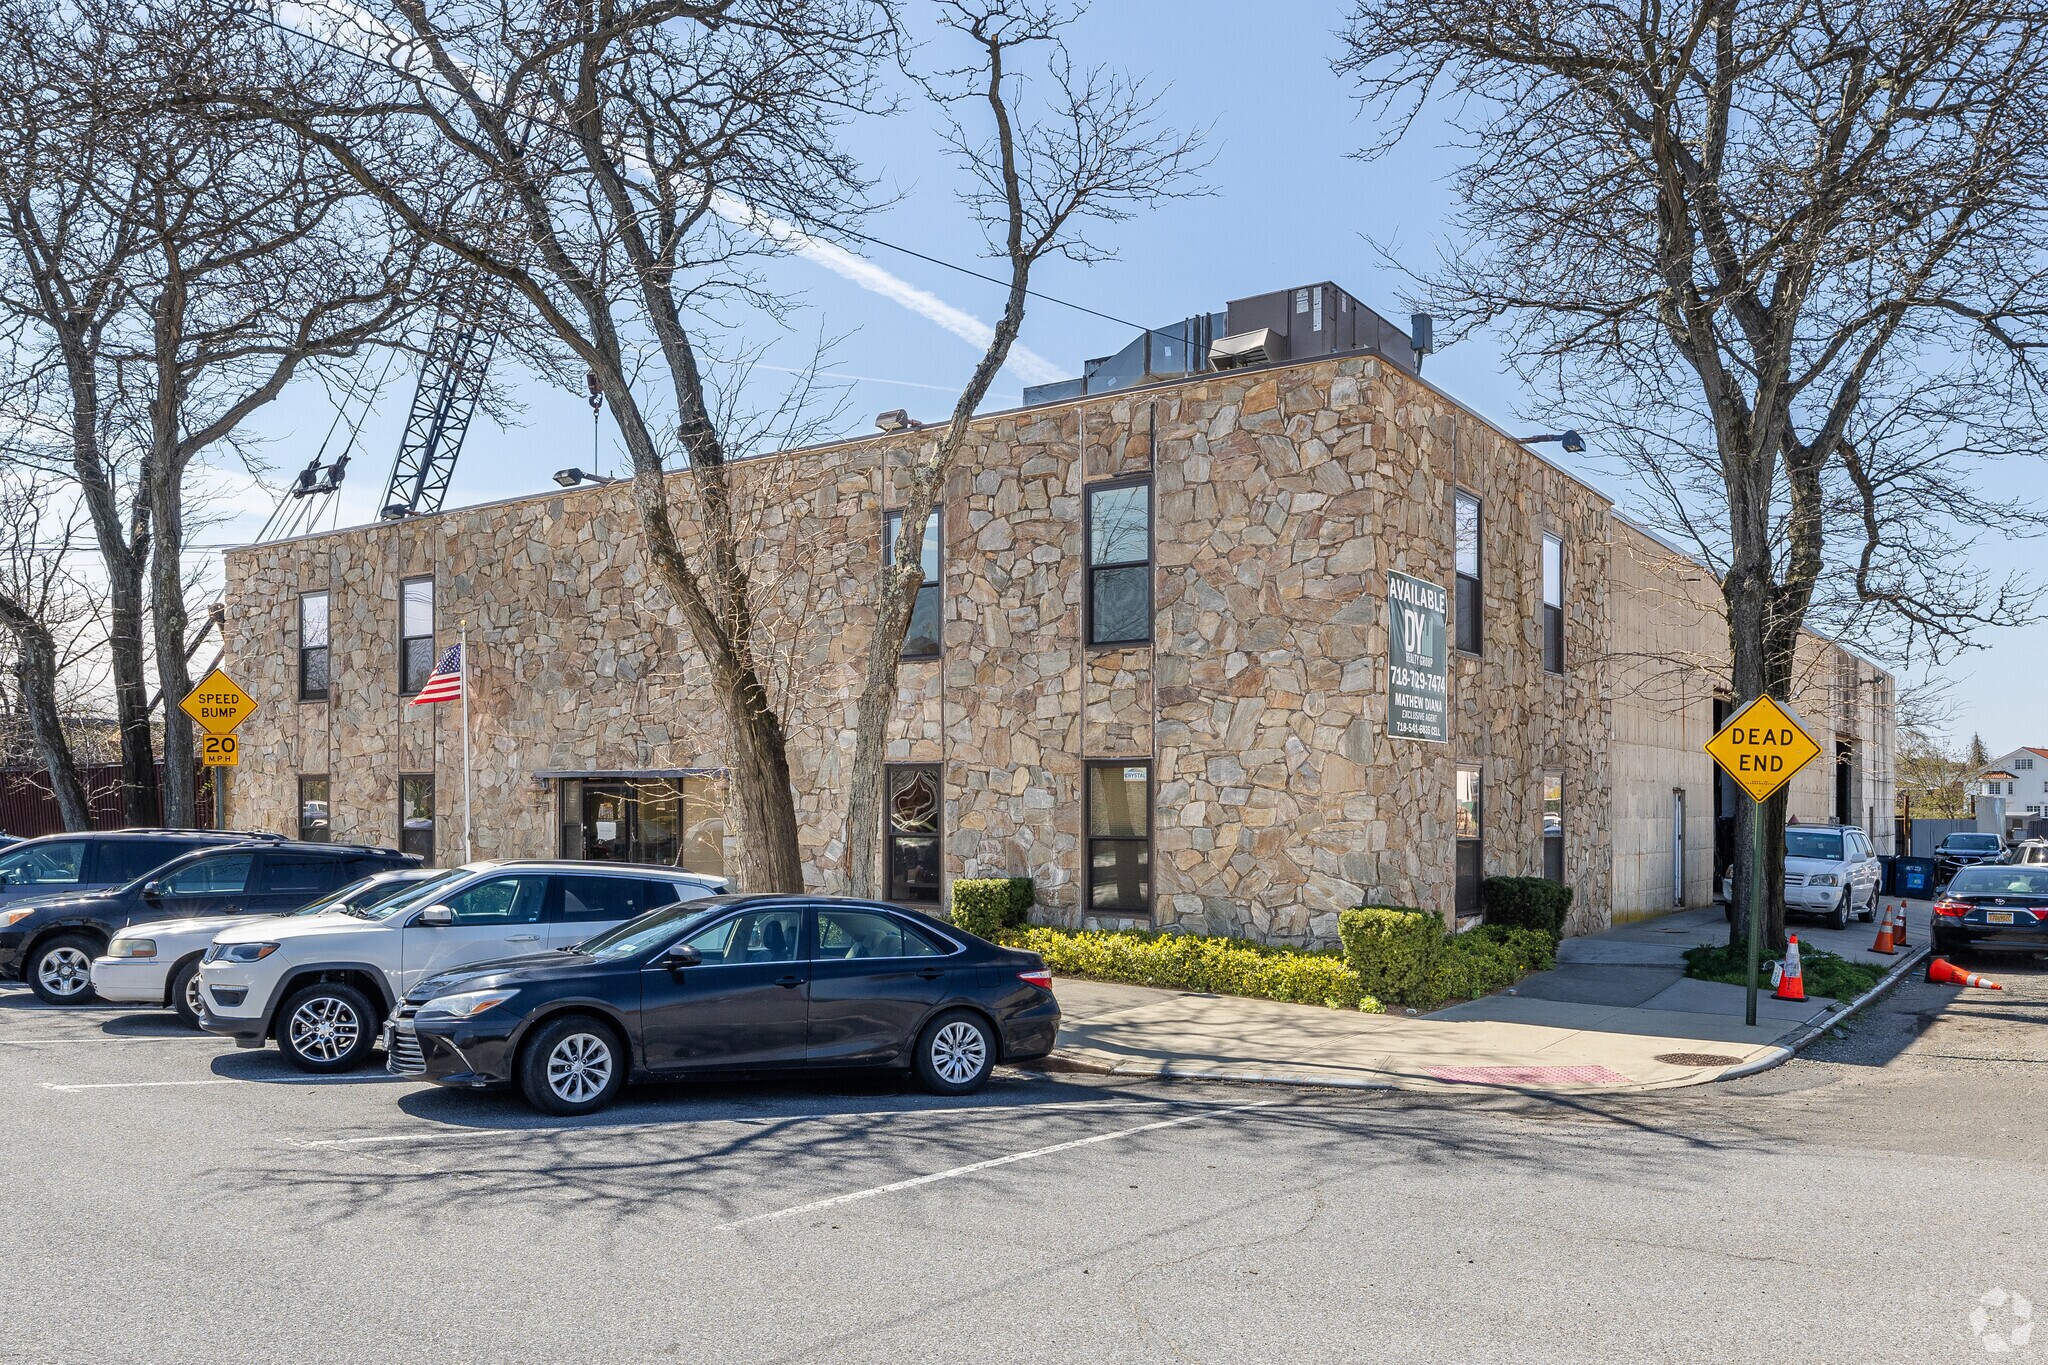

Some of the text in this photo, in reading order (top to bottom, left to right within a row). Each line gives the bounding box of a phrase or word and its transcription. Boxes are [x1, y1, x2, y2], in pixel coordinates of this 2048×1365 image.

[1389, 577, 1445, 614] AVAILABLE
[1404, 609, 1425, 655] DY
[1405, 651, 1433, 668] REALTY GROUP
[1390, 665, 1446, 694] 718-729-7474
[198, 693, 239, 704] SPEED
[1394, 692, 1443, 713] MATHEW DIANA
[201, 707, 237, 718] BUMP
[1402, 709, 1438, 723] EXCLUSIVE AGENT
[1431, 726, 1441, 737] CELL
[1731, 727, 1794, 746] DEAD
[205, 737, 236, 753] 20
[1739, 754, 1784, 772] END
